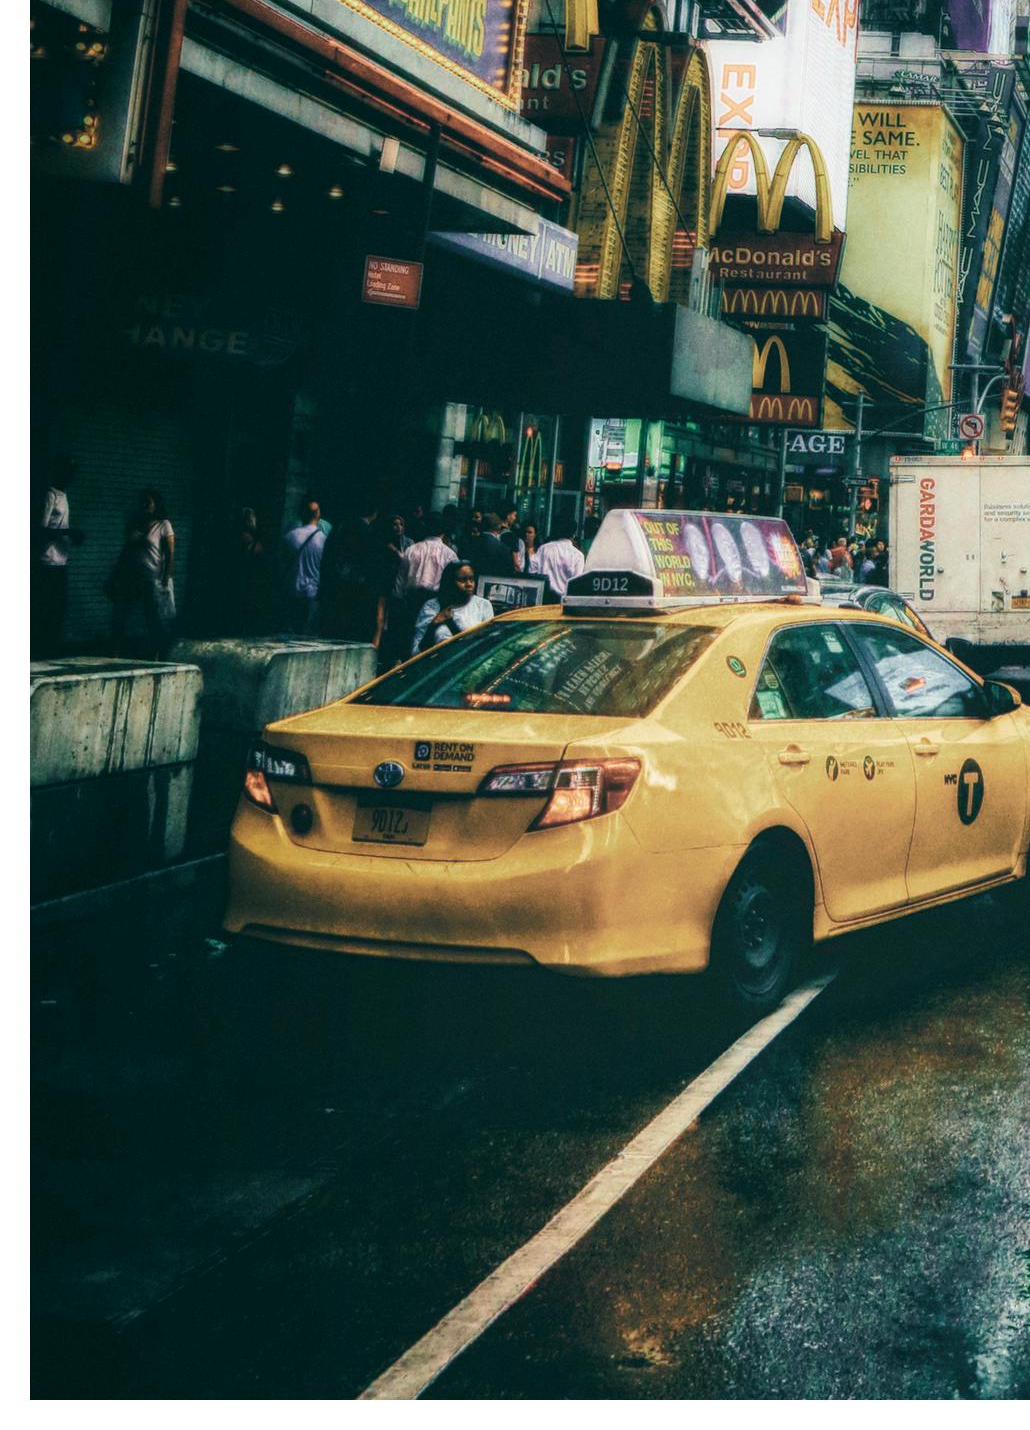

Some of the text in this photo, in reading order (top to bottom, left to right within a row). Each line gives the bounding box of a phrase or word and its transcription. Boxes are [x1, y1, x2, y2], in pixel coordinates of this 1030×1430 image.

[858, 113, 906, 127] WILL
[863, 131, 920, 147] SAME.
[874, 150, 908, 160] THAT
[545, 240, 578, 279] ATM
[708, 247, 831, 267] McDonald's
[369, 261, 409, 275] NO STANDING
[719, 267, 808, 281] Restaurant
[644, 522, 680, 536] OUT OF
[649, 538, 673, 551] THIS
[655, 555, 691, 569] WORLD
[592, 577, 628, 592] 9D12
[660, 572, 671, 586] IN
[713, 722, 752, 739] 9D12
[434, 743, 473, 752] RENT ON
[433, 752, 474, 761] DEMAND
[944, 774, 957, 785] NYC
